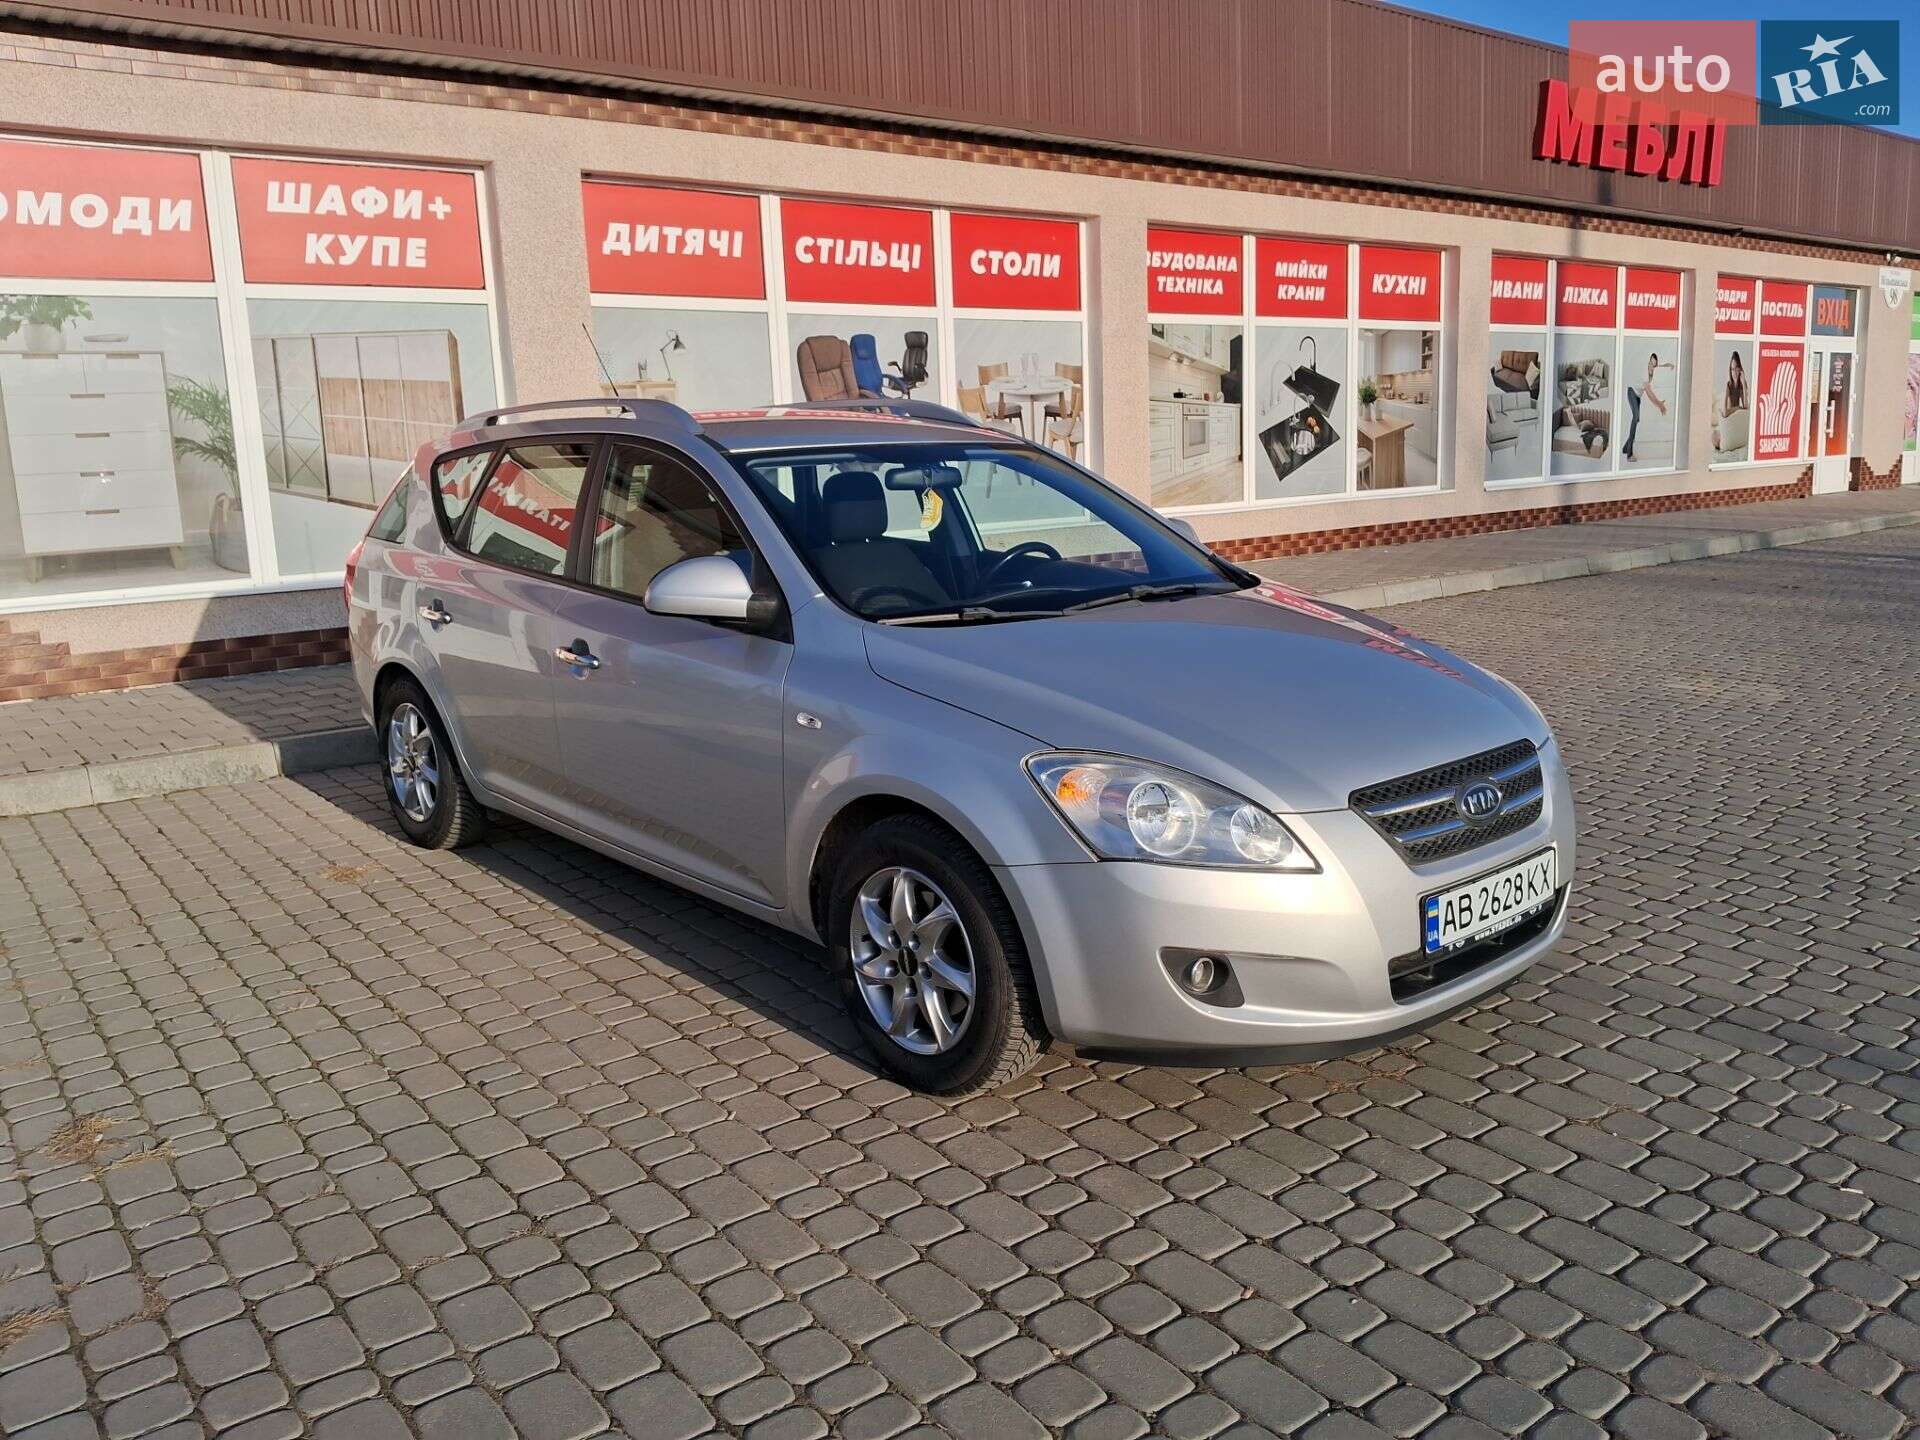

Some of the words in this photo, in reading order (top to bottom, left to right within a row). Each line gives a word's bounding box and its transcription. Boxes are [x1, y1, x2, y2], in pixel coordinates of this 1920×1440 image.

[1538, 79, 1727, 187] МЕБЛІ
[0, 189, 193, 236] МОДИ
[266, 180, 452, 222] ШАФИ+
[304, 233, 428, 269] КУПЕ
[601, 222, 744, 259] ДИТЯЧІ
[794, 235, 922, 271] СТІЛЬЦІ
[969, 248, 1062, 279] СТОЛИ
[1275, 259, 1328, 281] МИЙКИ
[1156, 275, 1224, 296] ТЕХНІКА
[1277, 284, 1326, 302] КРАНИ
[1372, 273, 1427, 296] КУХНІ
[1491, 279, 1544, 301] ИВАНИ
[1562, 285, 1609, 306] ЛІЖКА
[1627, 291, 1677, 311] МАТРАЦИ
[1762, 301, 1804, 318] ПОСТІЛЬ
[1817, 297, 1850, 330] ВХІД
[1467, 789, 1495, 815] KIA
[1442, 893, 1474, 937] AB
[1478, 872, 1524, 923] 2628
[1526, 859, 1551, 901] KX
[1427, 931, 1439, 942] UA
